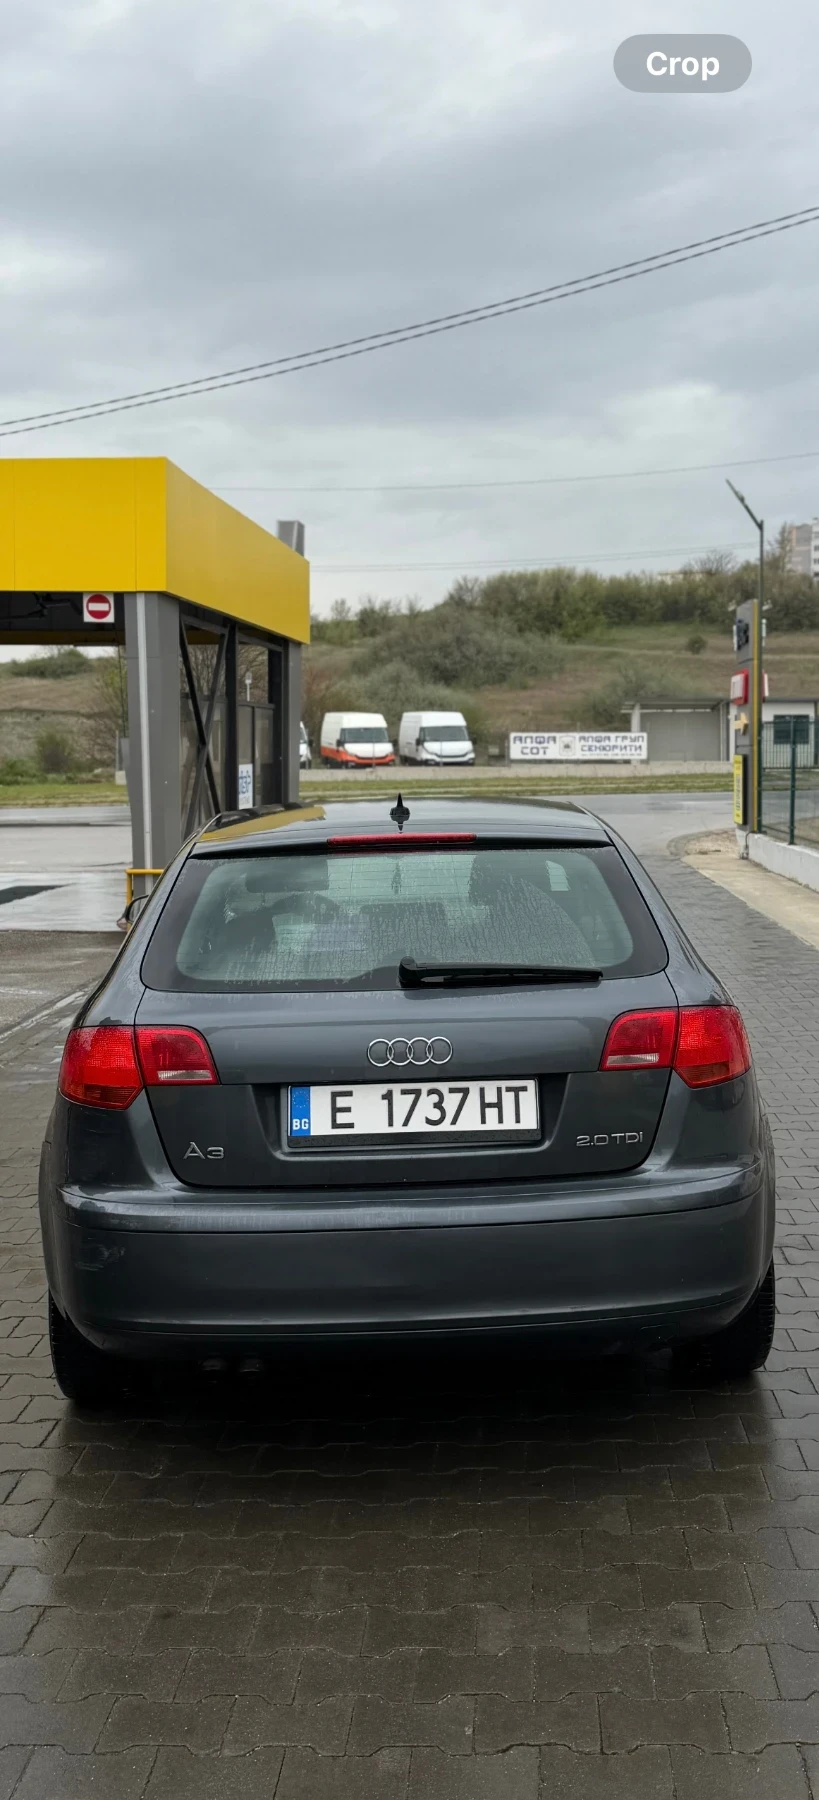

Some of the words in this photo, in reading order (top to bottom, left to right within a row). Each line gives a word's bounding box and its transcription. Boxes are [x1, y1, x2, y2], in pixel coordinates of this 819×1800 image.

[520, 746, 549, 755] СОТ
[330, 1090, 355, 1130] E
[292, 1118, 309, 1130] BG
[576, 1134, 609, 1147] 2.0
[183, 1141, 225, 1160] A3
